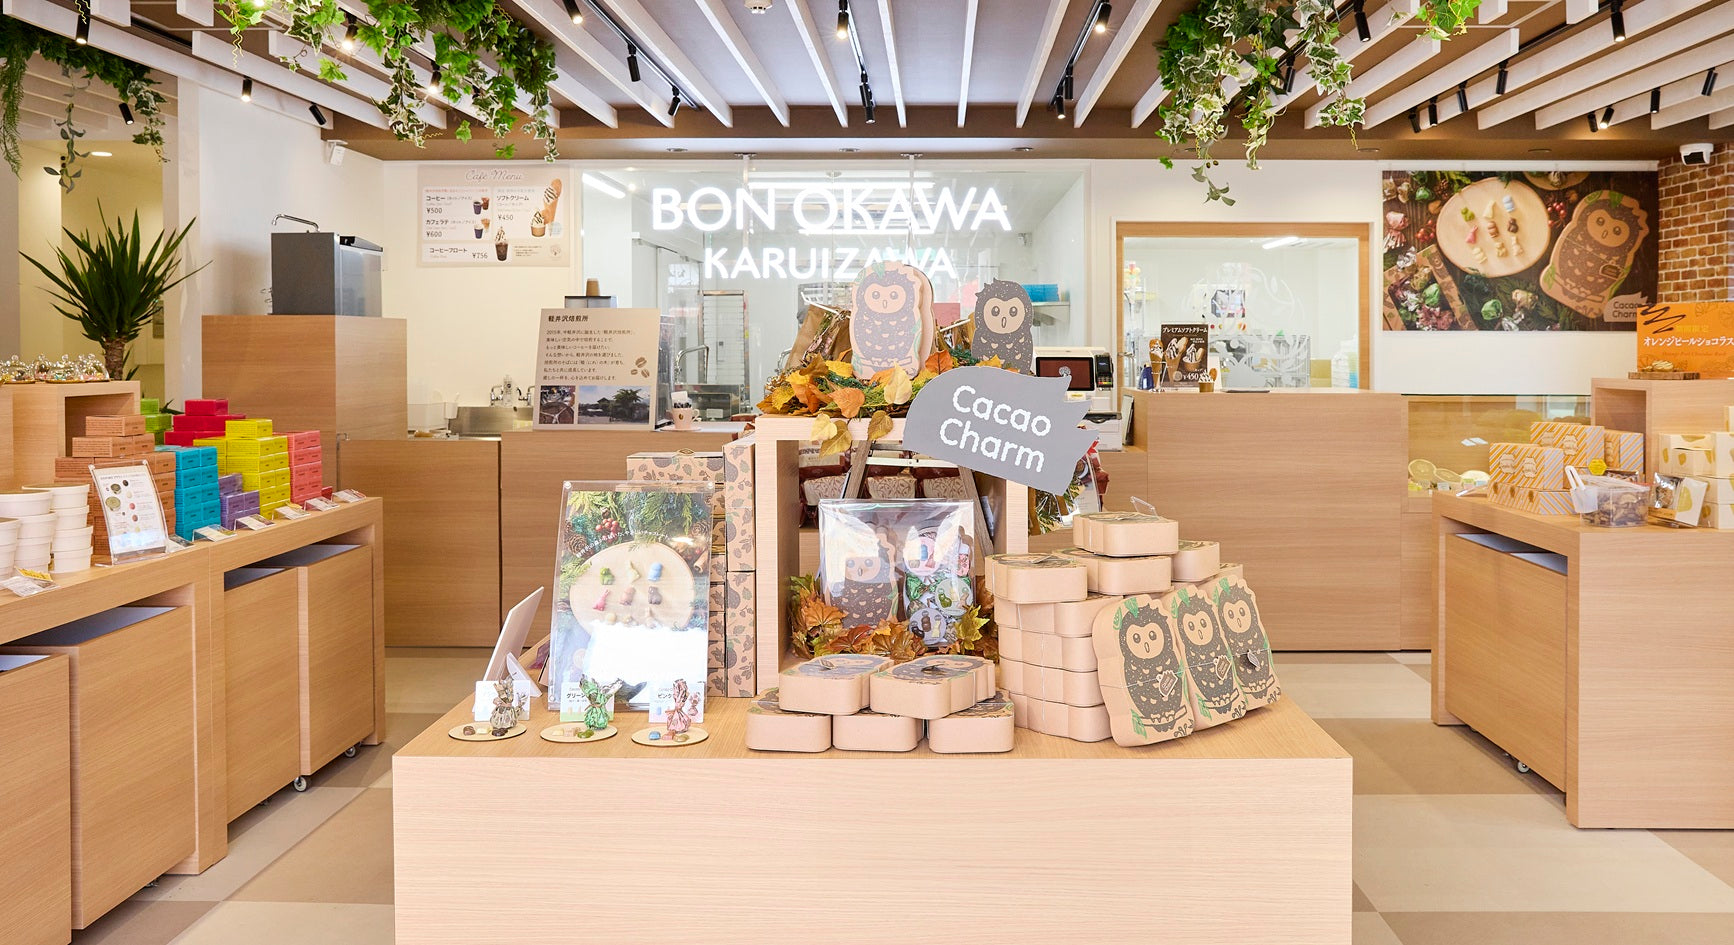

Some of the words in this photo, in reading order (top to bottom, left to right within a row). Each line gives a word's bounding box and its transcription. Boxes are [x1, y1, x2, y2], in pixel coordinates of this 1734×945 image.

[491, 169, 523, 181] Menu
[496, 194, 530, 202] ソフトクリーム
[652, 187, 776, 231] BON
[793, 186, 1012, 231] OKAWA
[953, 385, 1051, 436] Cacao
[940, 418, 1044, 472] Charm
